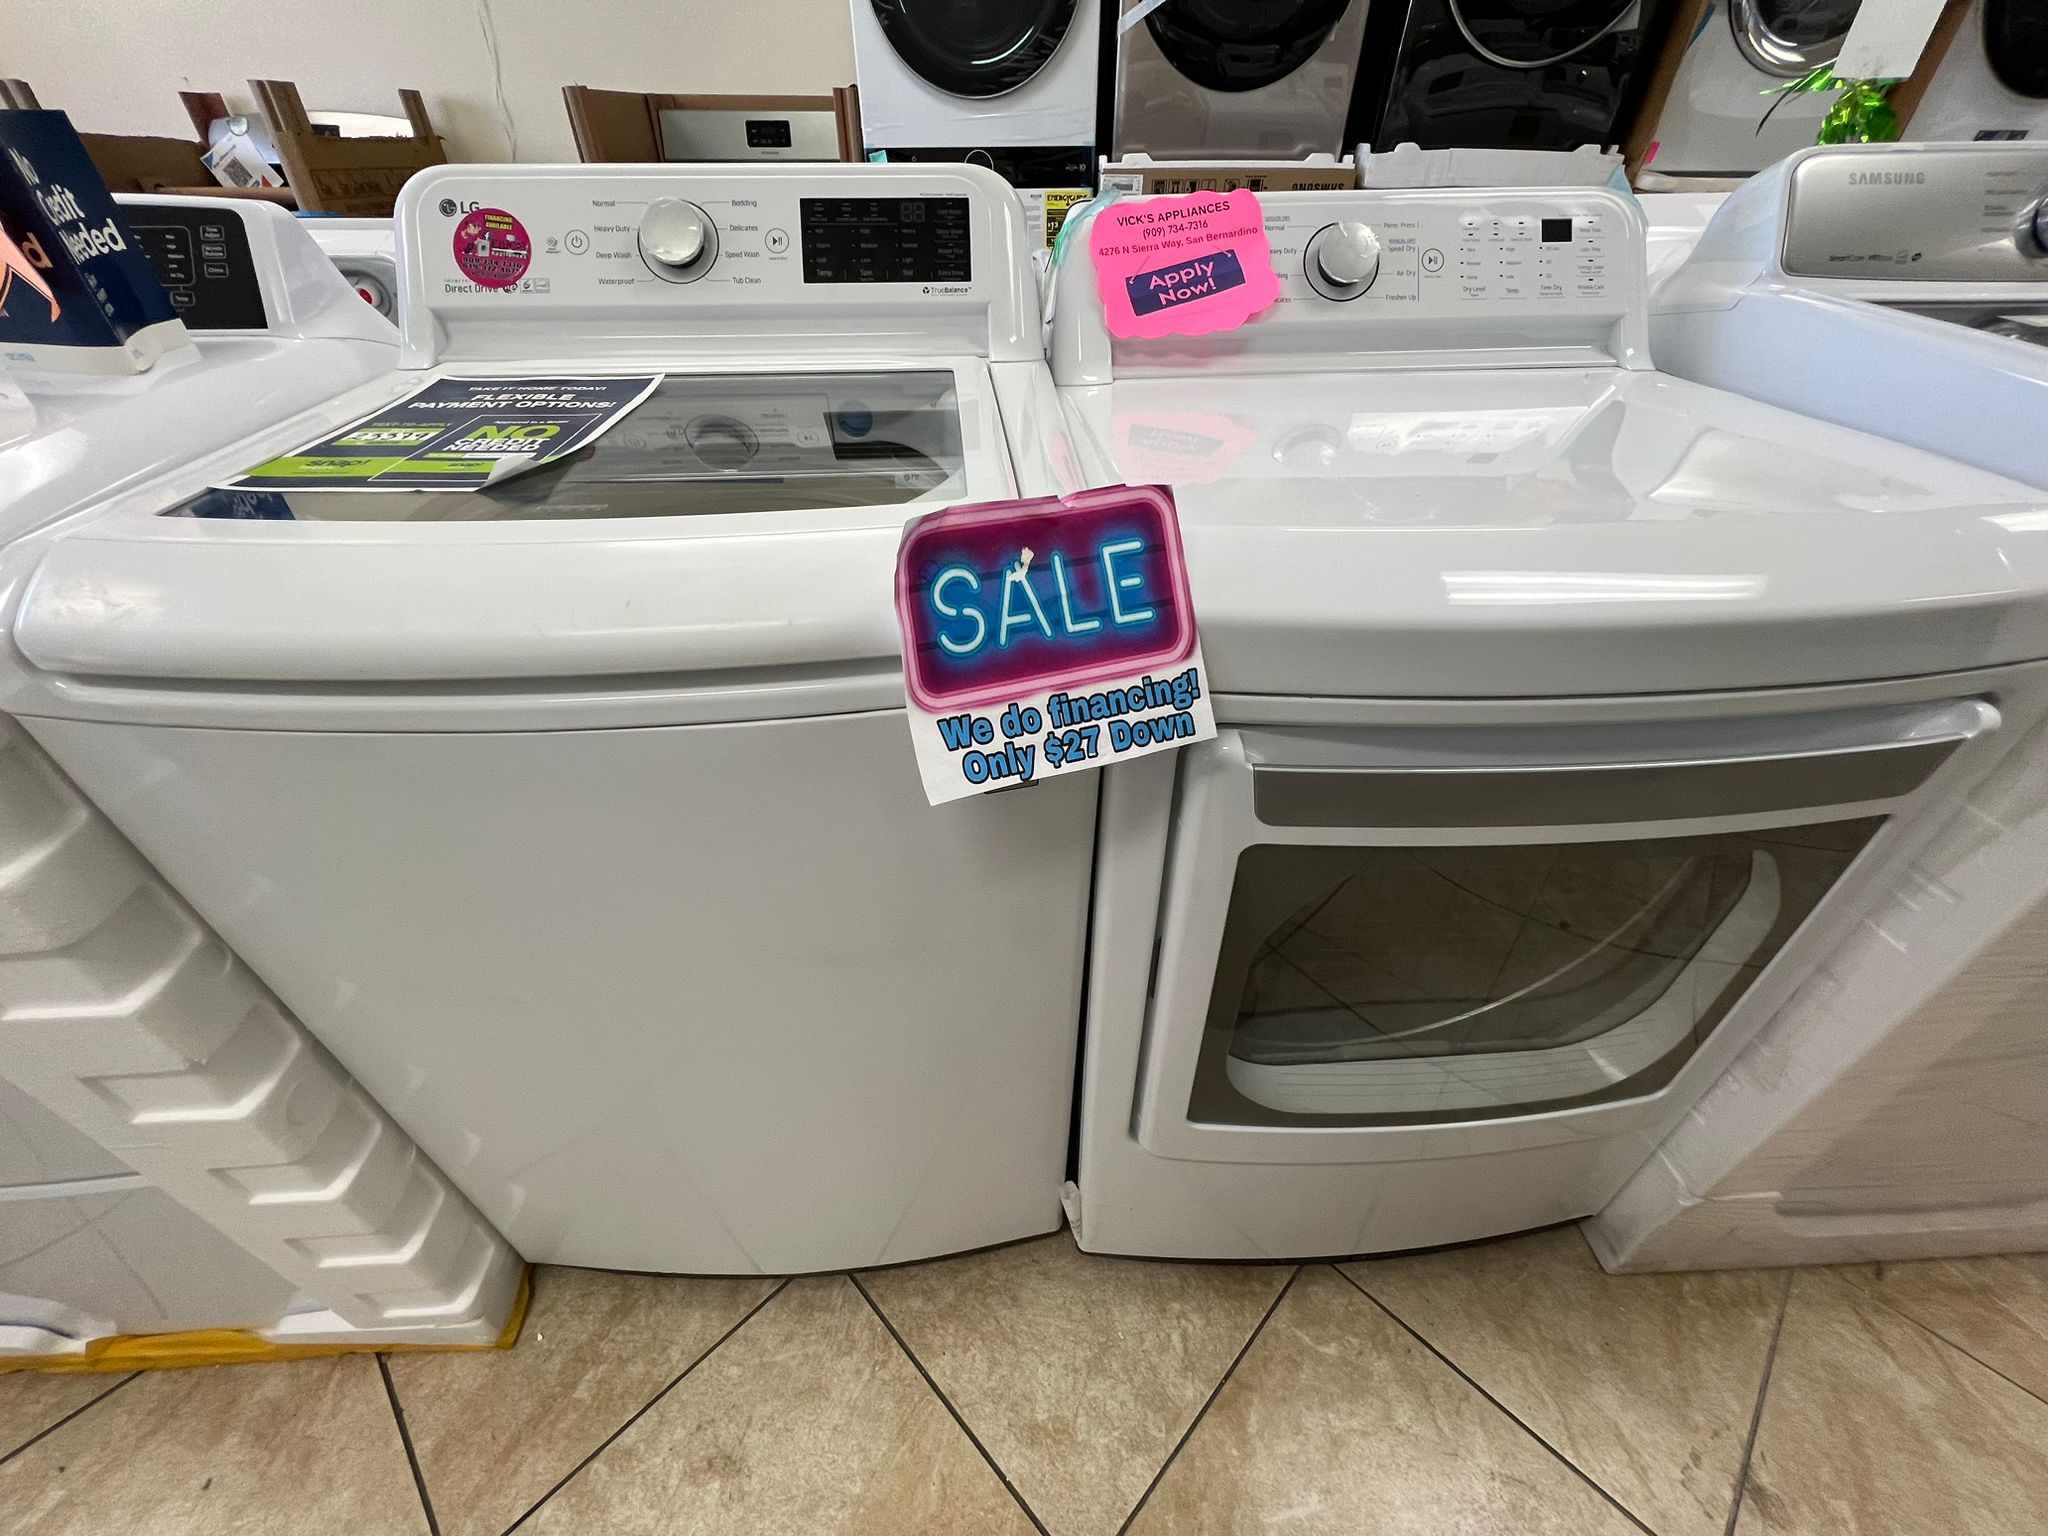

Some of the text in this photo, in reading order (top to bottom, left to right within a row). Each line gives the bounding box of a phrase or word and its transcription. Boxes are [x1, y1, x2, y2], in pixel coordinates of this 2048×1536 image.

[1849, 172, 1926, 185] SAMSUNG
[36, 183, 86, 226] Credit
[460, 200, 481, 214] LG
[731, 200, 758, 208] Bedding
[1117, 201, 1231, 227] VICK'S APPLIANCES
[593, 224, 630, 234] Heavy Duty
[729, 224, 758, 233] Delicates
[1143, 220, 1209, 240] (909) 734-7316
[58, 217, 127, 266] Needed
[1099, 226, 1258, 257] 4276 N Sierra Way, San Bernardino
[596, 252, 612, 260] Deep
[725, 251, 742, 260] Speed
[598, 278, 635, 286] Waterproof
[1149, 261, 1215, 290] Apply
[445, 283, 473, 294] Direct
[1158, 277, 1217, 306] Now!
[471, 393, 576, 401] FLEXIBLE
[408, 401, 617, 409] PAYMENT OPTIONS!
[464, 424, 562, 440] NO
[441, 444, 541, 452] NEEDED
[453, 438, 550, 446] CREDIT
[931, 537, 1154, 654] SALE
[937, 667, 1202, 751] We do financing!
[962, 711, 1196, 783] Only $27 Down
